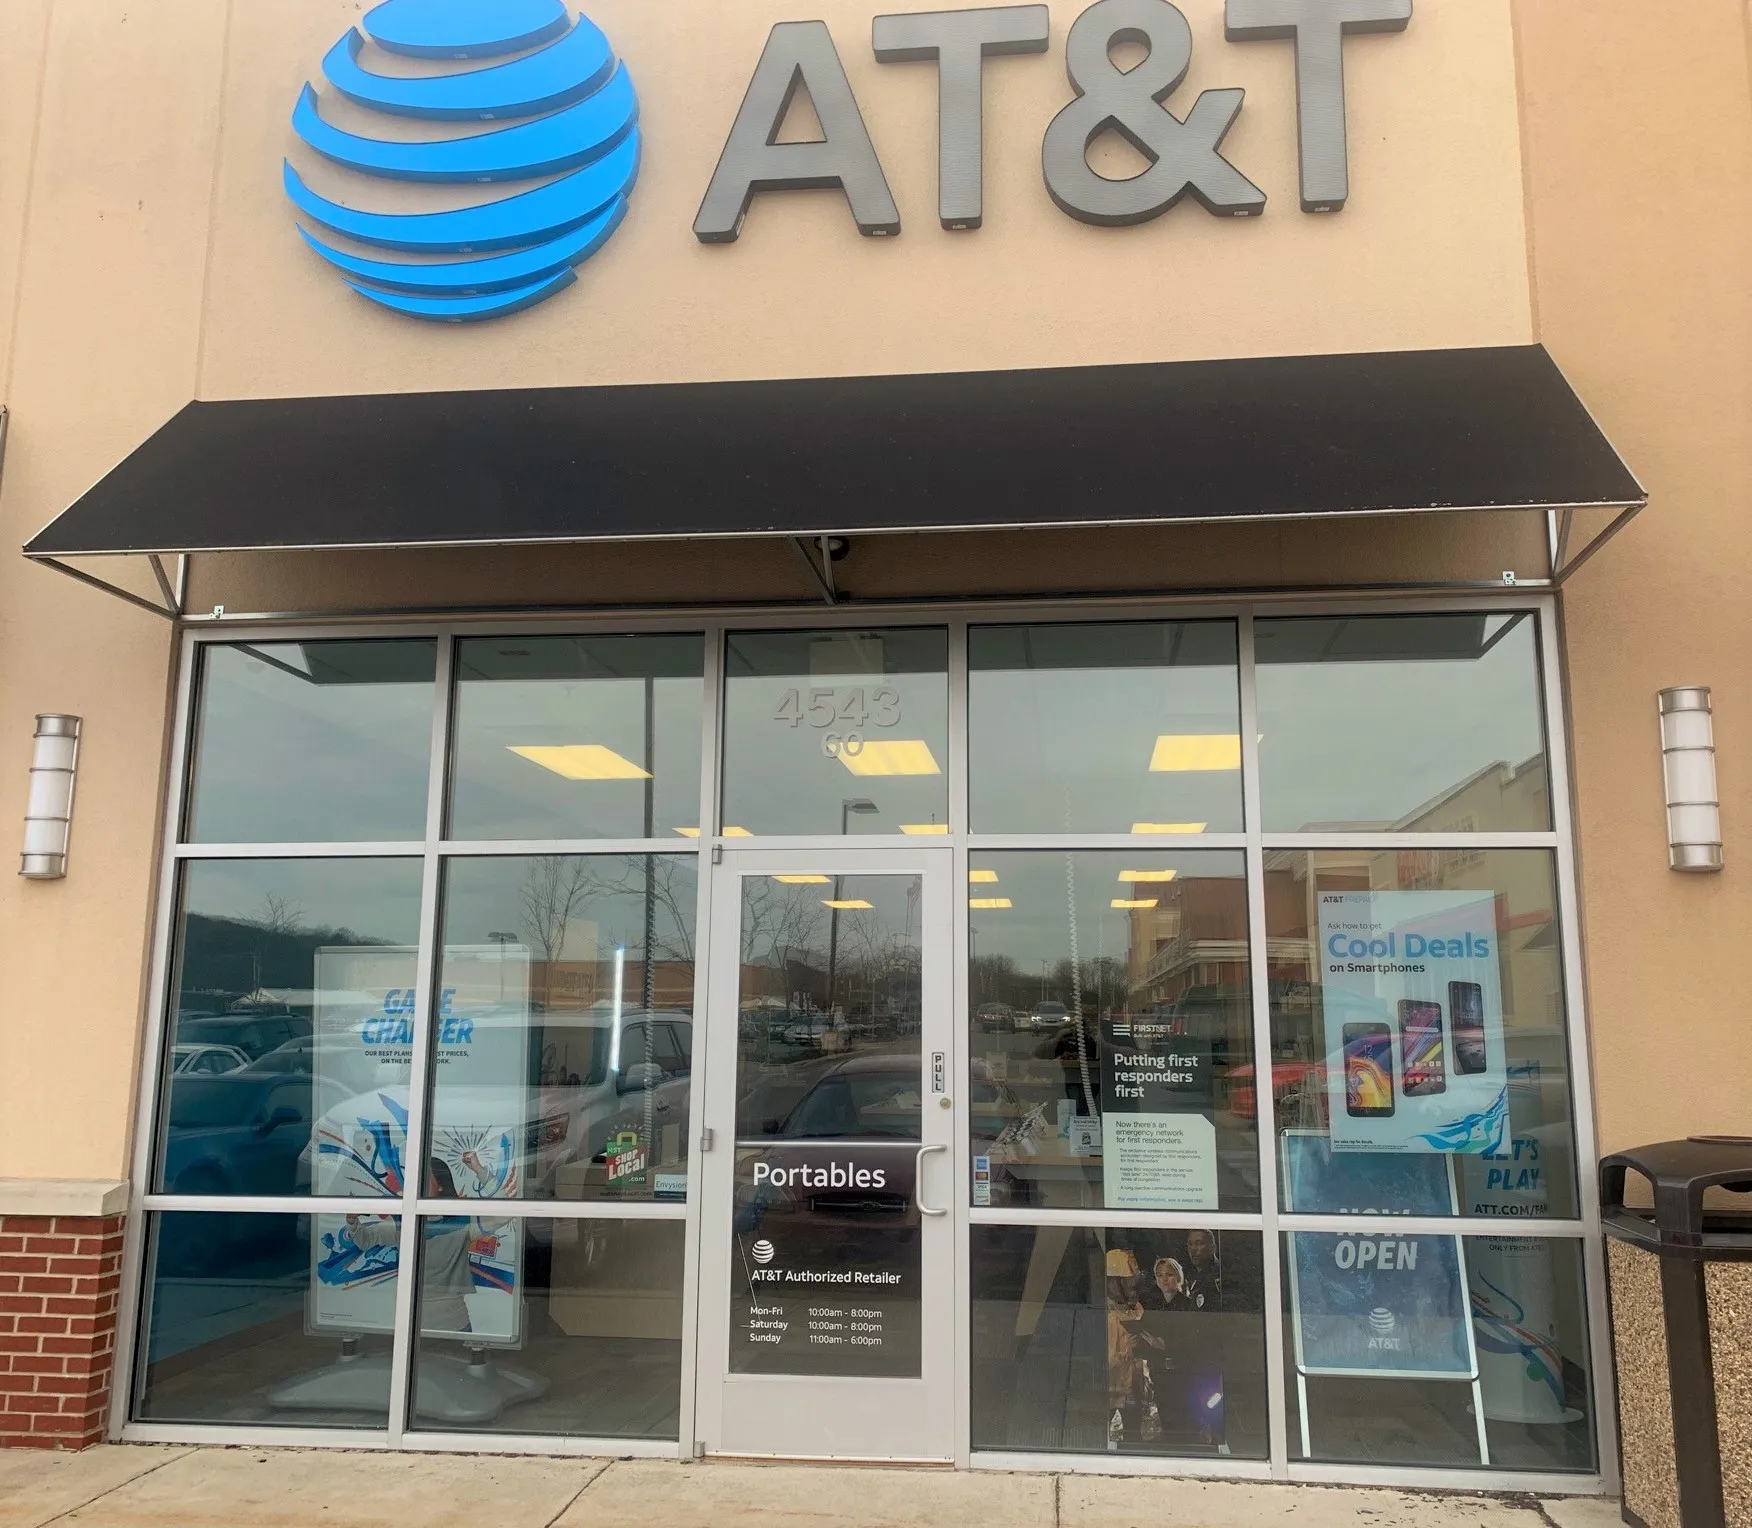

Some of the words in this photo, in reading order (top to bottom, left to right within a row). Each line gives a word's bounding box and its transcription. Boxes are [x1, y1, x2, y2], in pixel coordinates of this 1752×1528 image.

[693, 0, 1412, 242] AT&T
[773, 687, 901, 728] 4543
[821, 730, 864, 759] 60
[1370, 923, 1382, 931] get
[1328, 932, 1396, 958] Cool
[1405, 932, 1489, 958] Deals
[1329, 964, 1344, 972] on
[1347, 963, 1425, 974] Smartphones
[384, 988, 456, 1014] GAE
[362, 1018, 474, 1044] CHAER
[1114, 1053, 1165, 1069] Putting
[1168, 1054, 1198, 1067] first
[1115, 1070, 1193, 1084] responders
[1115, 1084, 1144, 1098] first
[1142, 1137, 1183, 1145] responders.
[615, 1149, 638, 1165] SHOP
[753, 1161, 886, 1188] Portables
[1486, 1168, 1539, 1190] PLAY
[655, 1181, 686, 1189] Envysion
[1335, 1239, 1418, 1270] OPEN
[752, 1269, 783, 1281] AT&T
[785, 1270, 851, 1283] Authorized
[854, 1271, 901, 1284] Retailer
[750, 1307, 783, 1316] Mon-Fri
[808, 1308, 842, 1317] 10:00am
[850, 1309, 882, 1319] 8:00pm
[750, 1320, 788, 1330] Saturday
[808, 1321, 842, 1330] 10:00am
[850, 1322, 882, 1333] 8:00pm
[750, 1333, 781, 1343] Sunday
[809, 1335, 842, 1344] 11:00am
[850, 1336, 882, 1346] 6:00pm
[1368, 1337, 1400, 1351] AT&T
